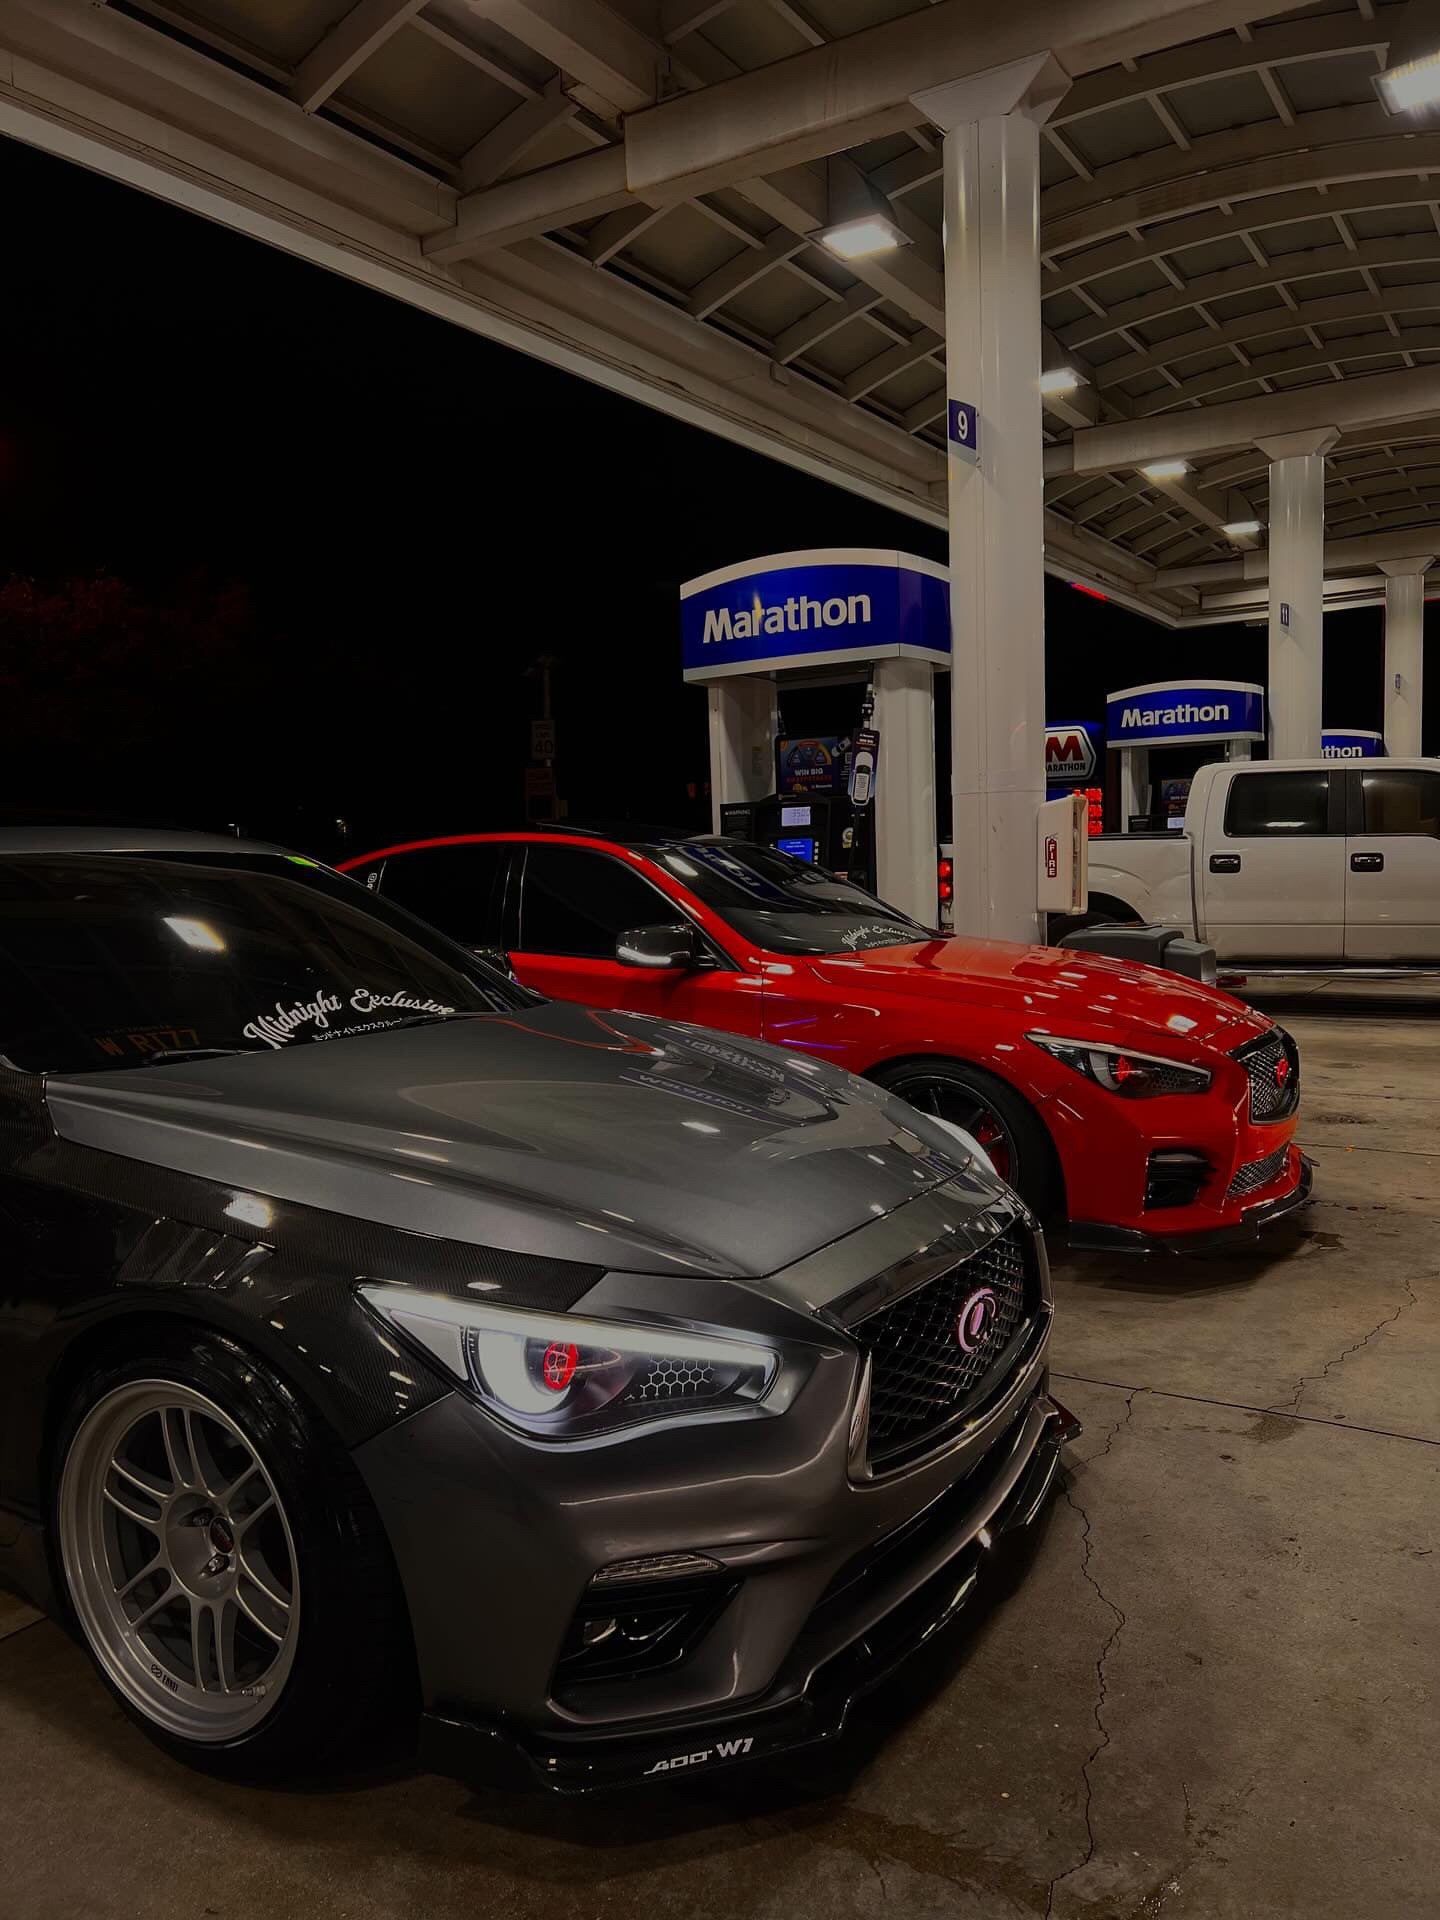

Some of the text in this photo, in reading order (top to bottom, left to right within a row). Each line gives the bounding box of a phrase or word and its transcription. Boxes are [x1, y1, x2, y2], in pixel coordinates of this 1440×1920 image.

[957, 409, 968, 440] 9
[702, 593, 871, 644] Marathon
[1120, 704, 1229, 728] Marathon
[1046, 735, 1084, 762] M
[1322, 745, 1363, 758] thon
[1046, 762, 1086, 772] ARATHON
[242, 988, 456, 1050] Midnight Exclusive
